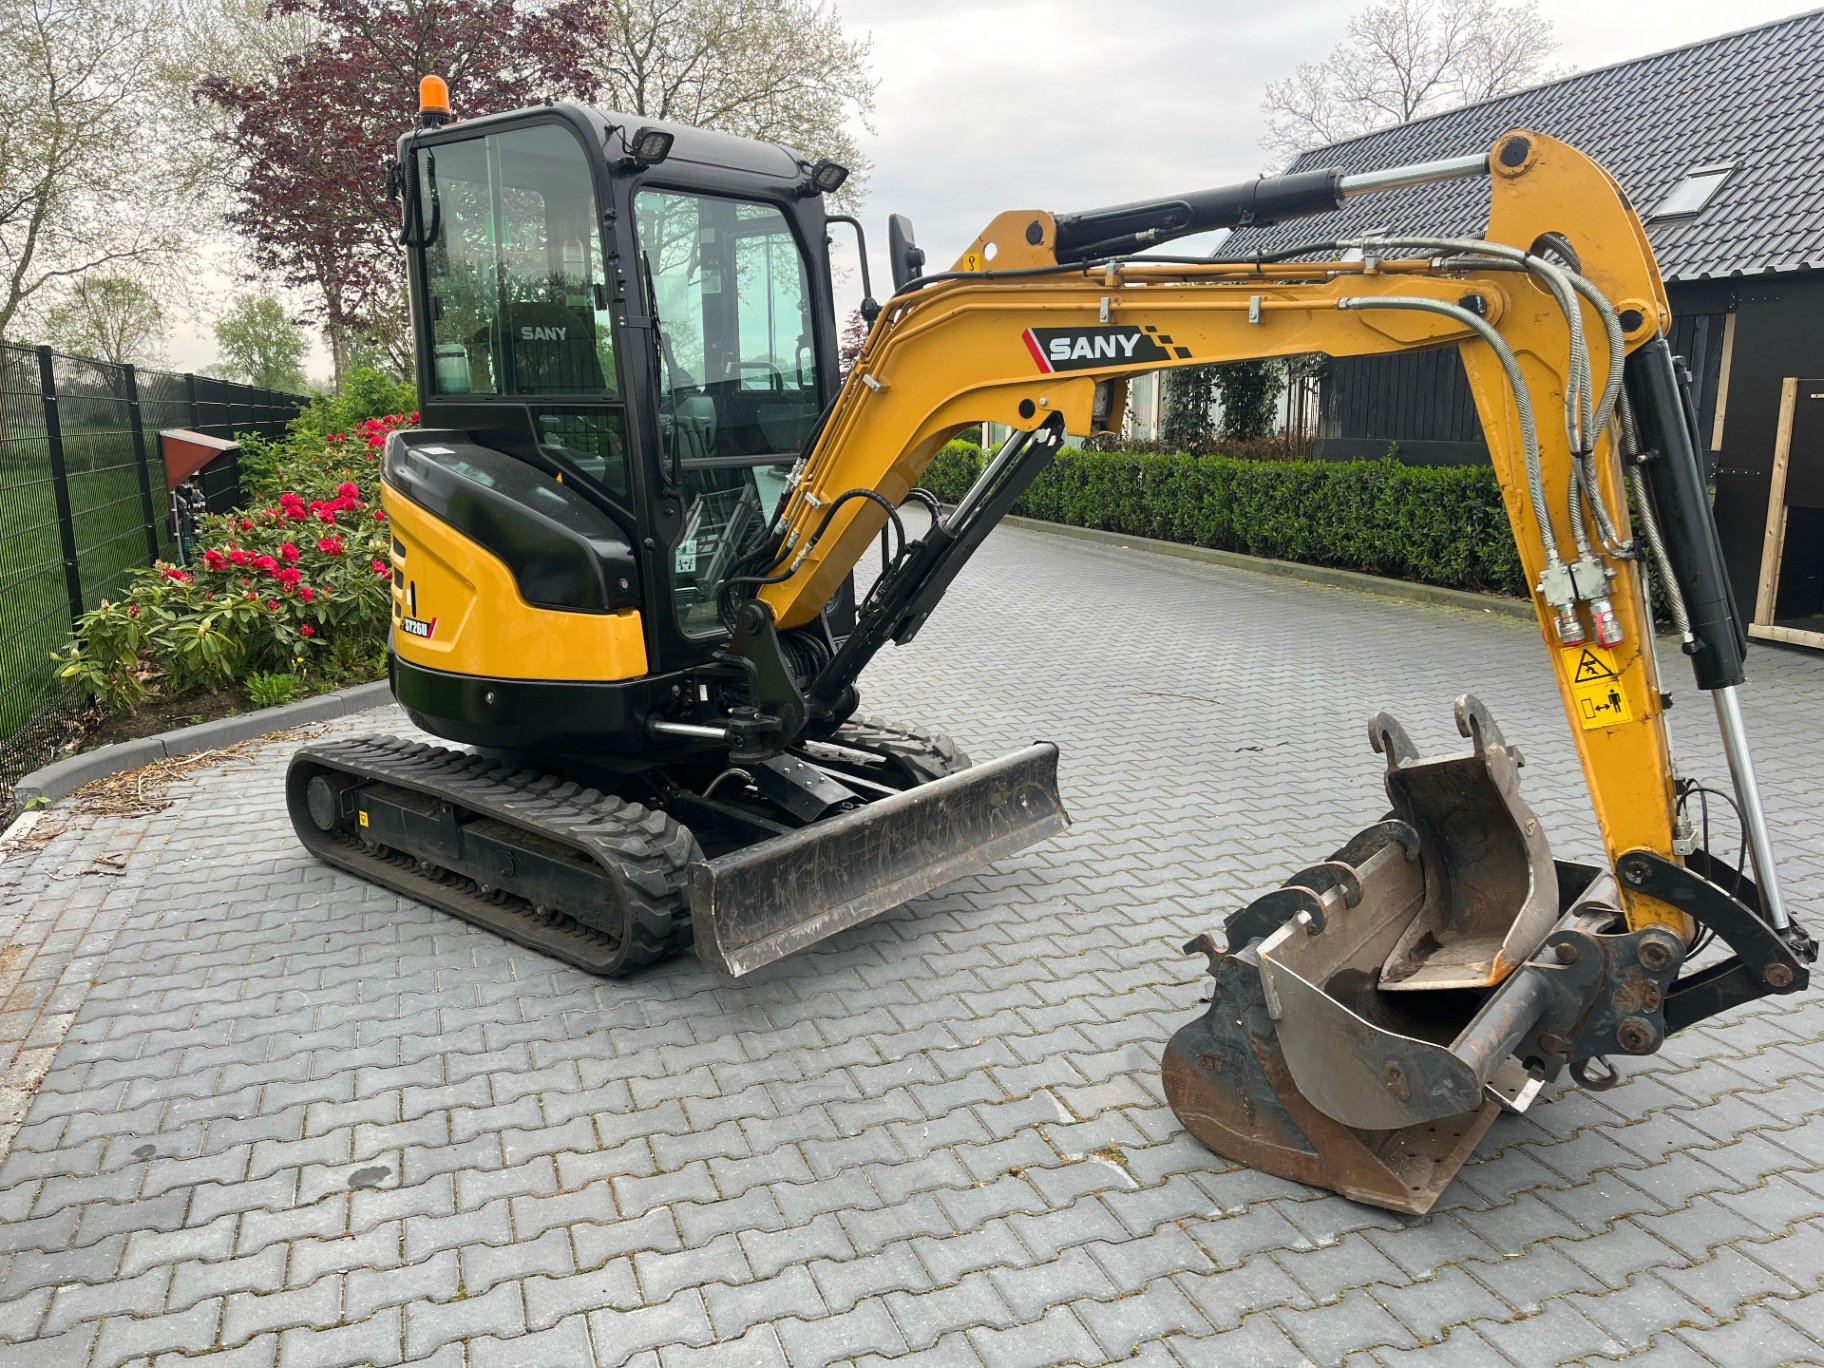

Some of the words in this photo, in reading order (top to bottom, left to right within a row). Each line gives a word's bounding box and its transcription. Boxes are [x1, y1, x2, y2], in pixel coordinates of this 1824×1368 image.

[521, 326, 567, 341] SANY
[1049, 333, 1141, 361] SANY
[405, 618, 428, 637] SY26U
